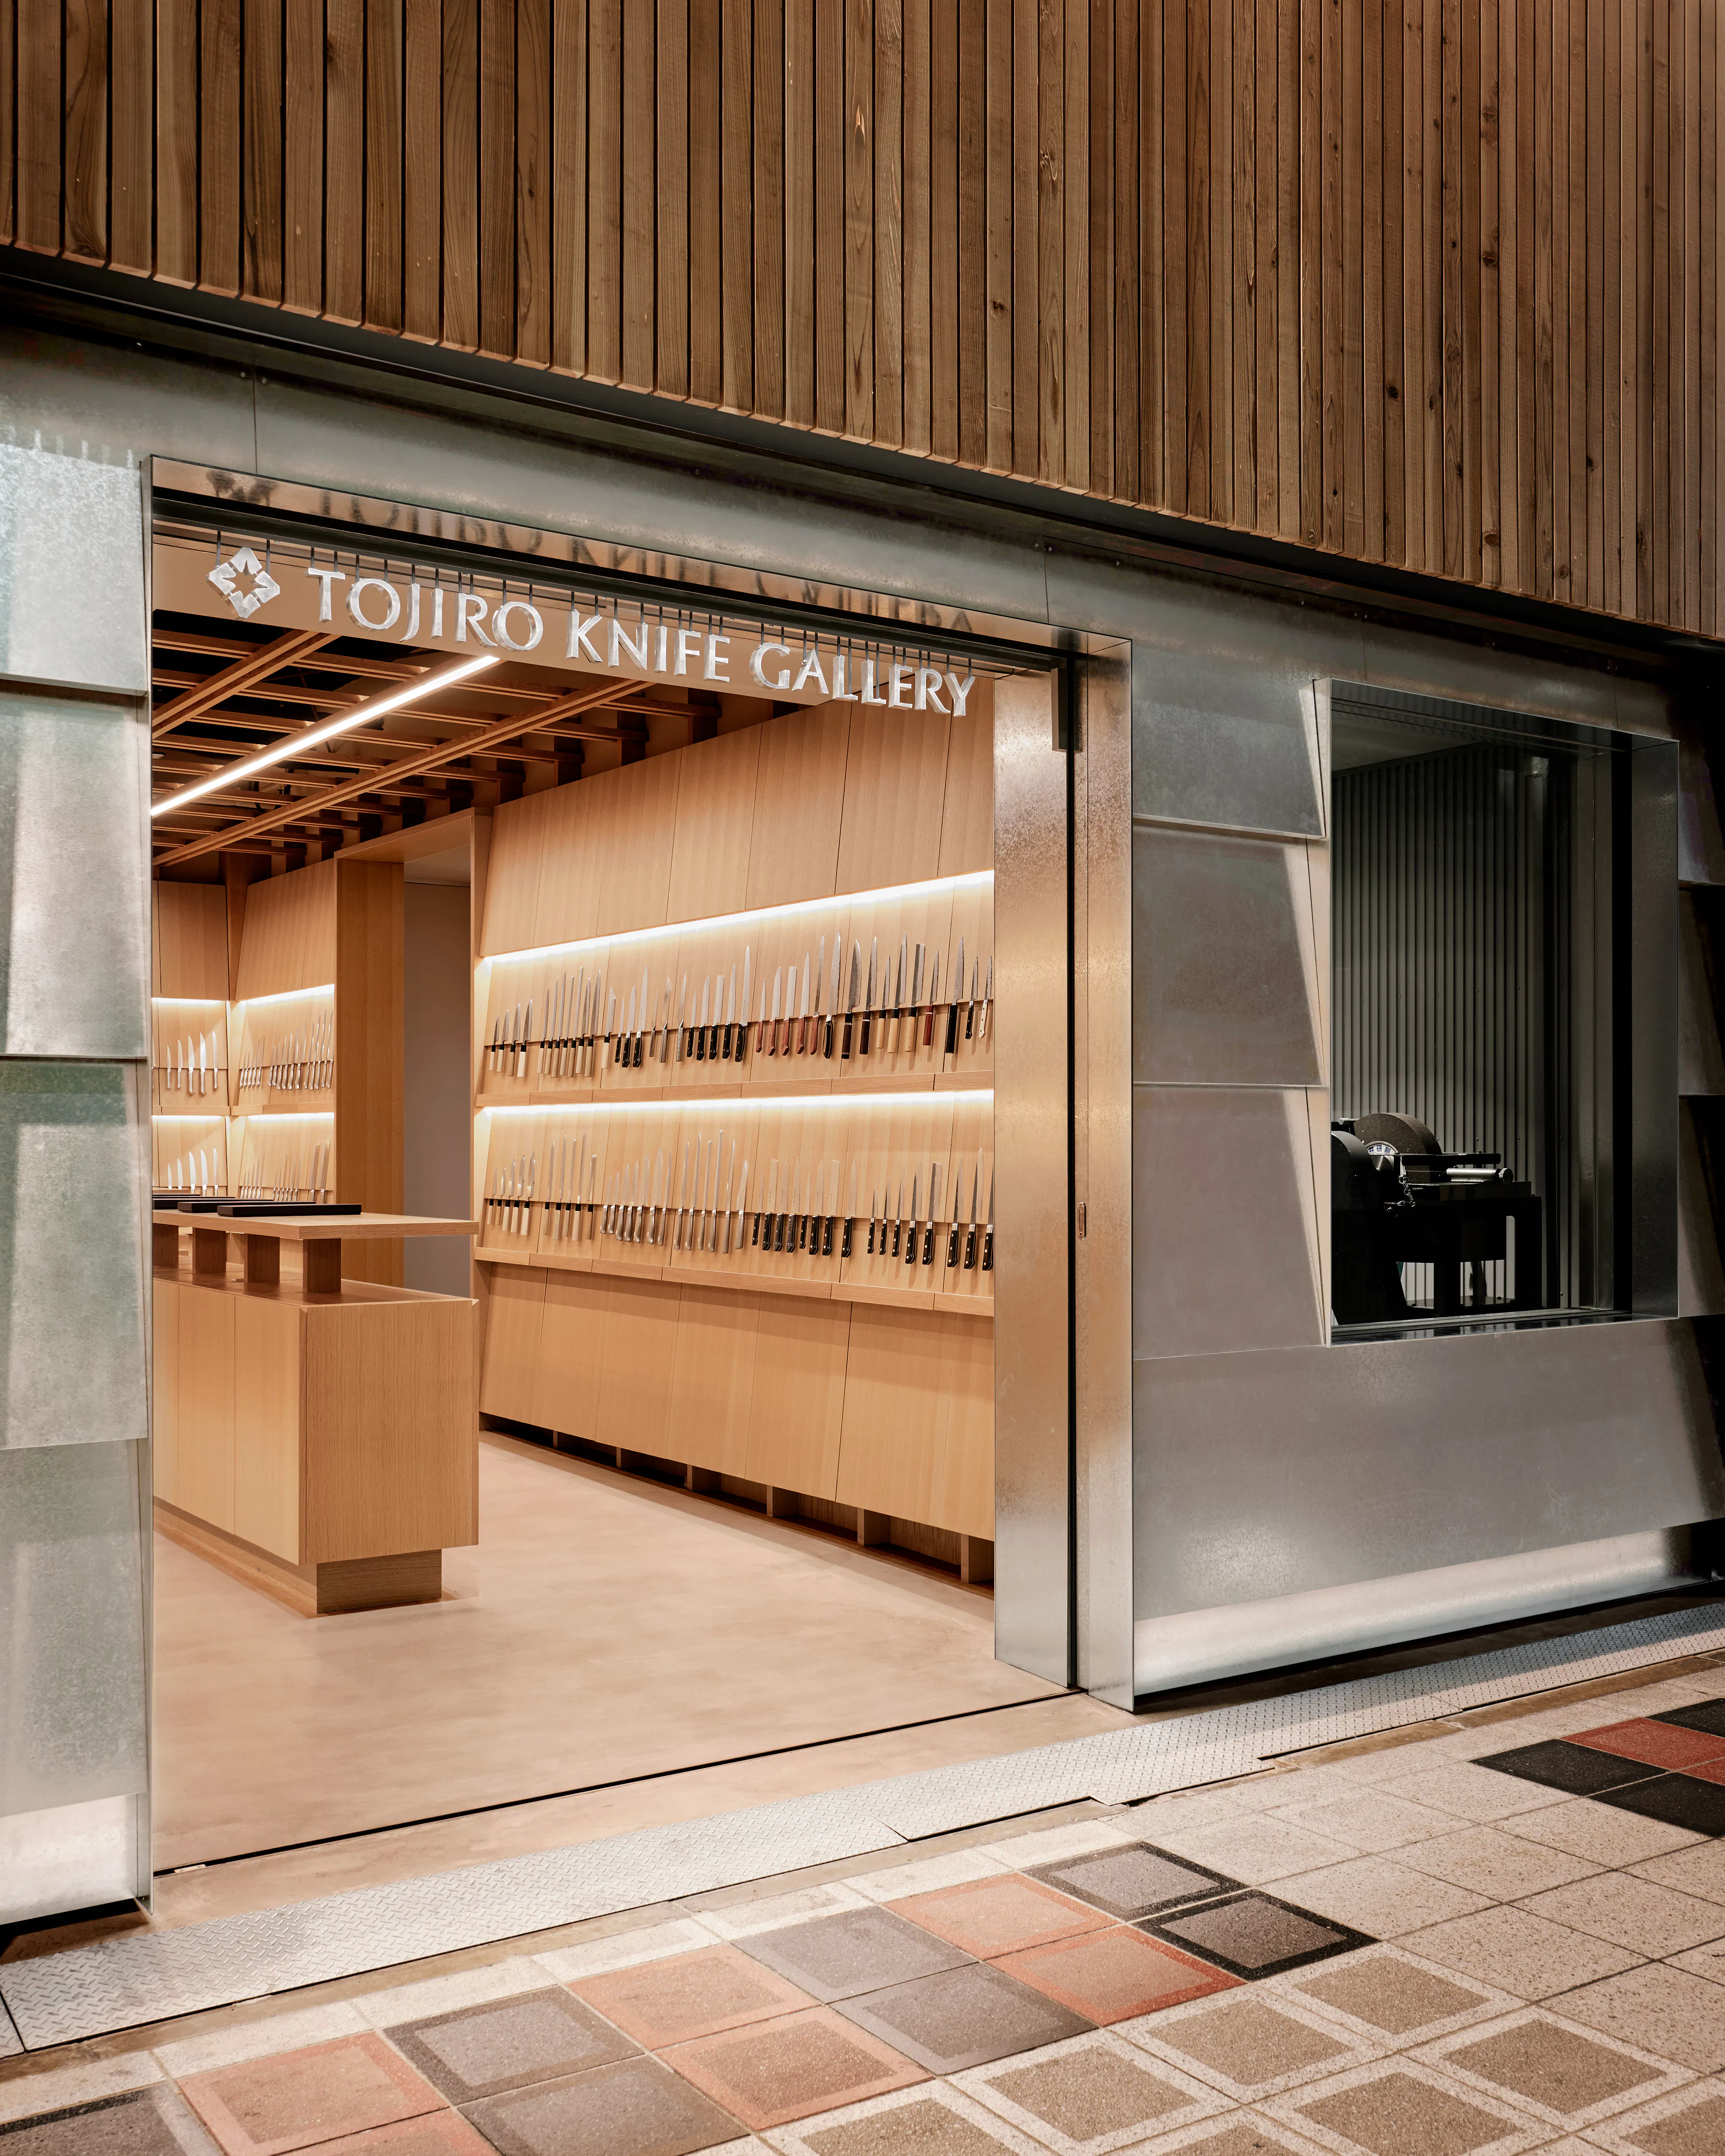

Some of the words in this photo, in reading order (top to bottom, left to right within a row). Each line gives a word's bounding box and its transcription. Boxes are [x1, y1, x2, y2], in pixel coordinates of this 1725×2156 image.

[305, 567, 544, 652] TOJIRO
[566, 609, 730, 682] KNIFE
[749, 642, 976, 717] GALLERY
